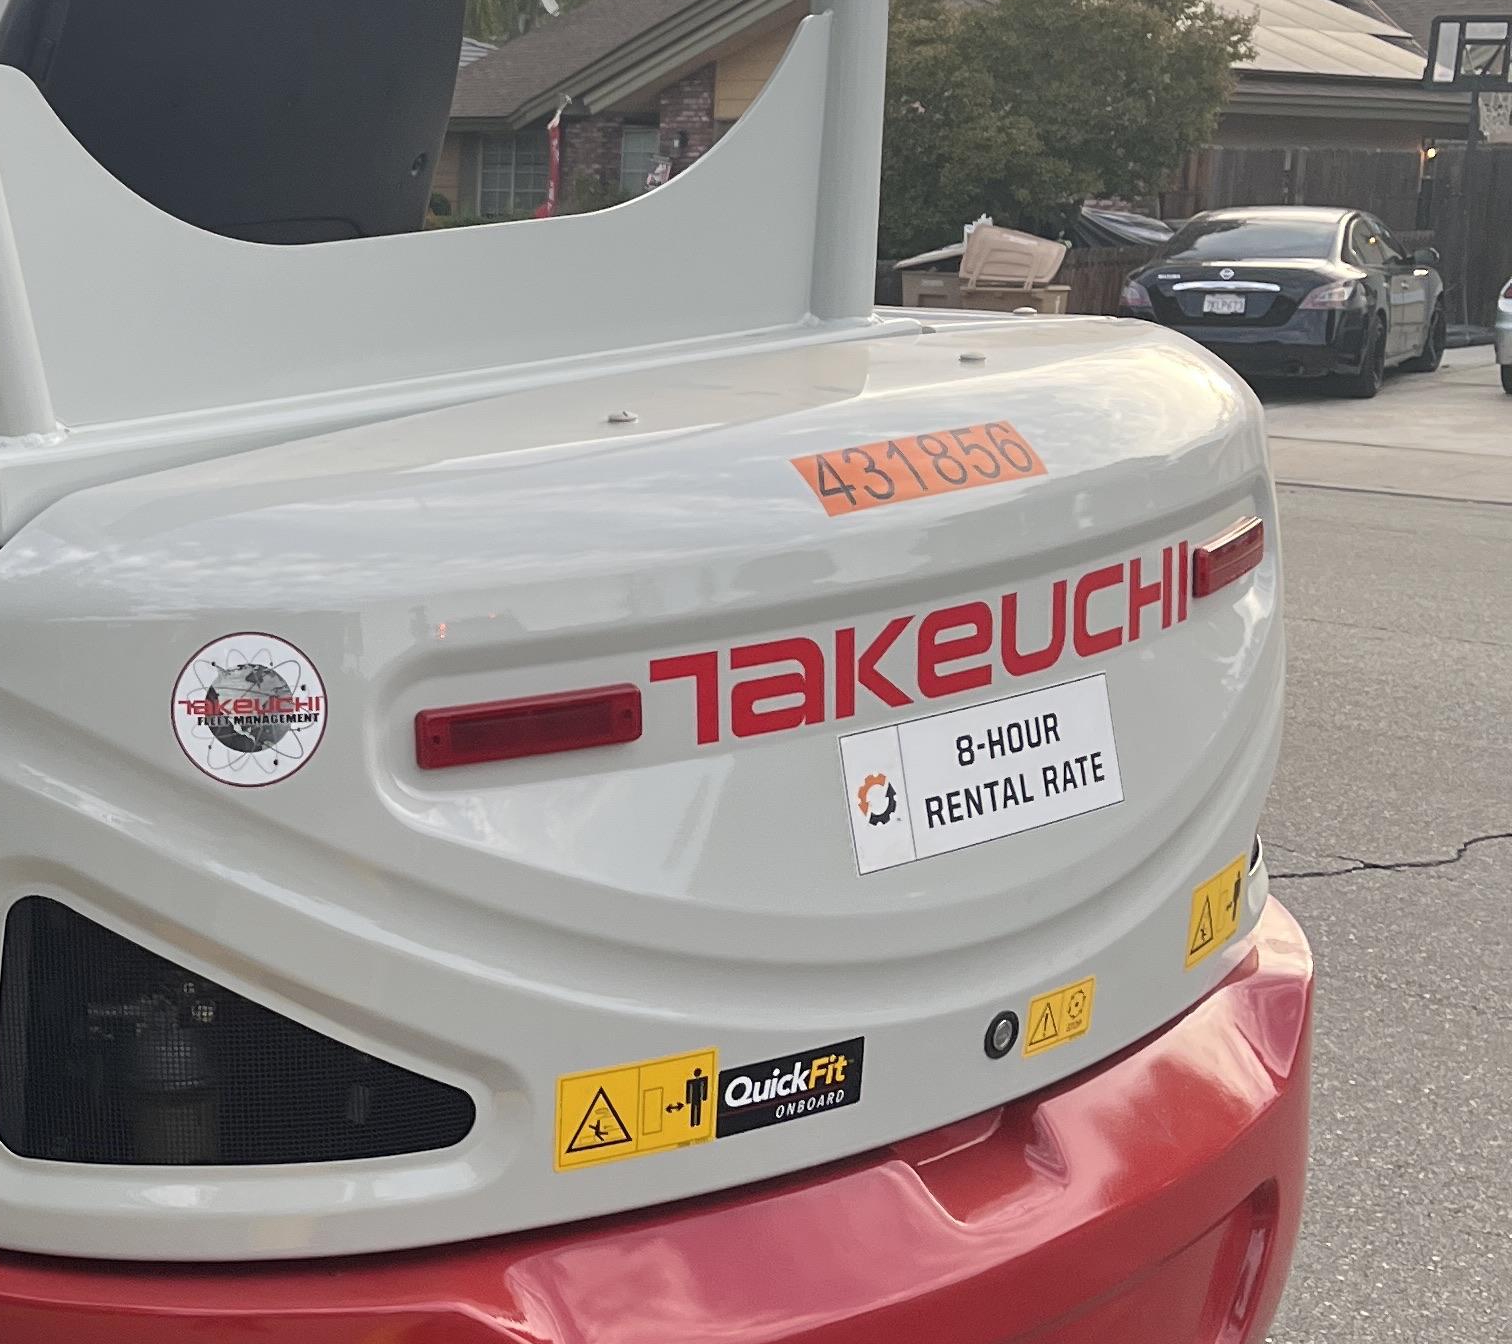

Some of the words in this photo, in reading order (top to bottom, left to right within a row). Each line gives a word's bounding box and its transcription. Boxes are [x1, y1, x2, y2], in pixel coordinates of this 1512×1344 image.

[816, 422, 1033, 506] 431856
[197, 715, 231, 726] FLEET
[233, 713, 320, 725] MANAGEMENT
[955, 712, 1061, 767] 8-HOUR
[925, 773, 1035, 829] RENTAL
[1042, 751, 1106, 798] RATE
[724, 1054, 848, 1108] QuickFit
[775, 1089, 845, 1119] ONBOARD
